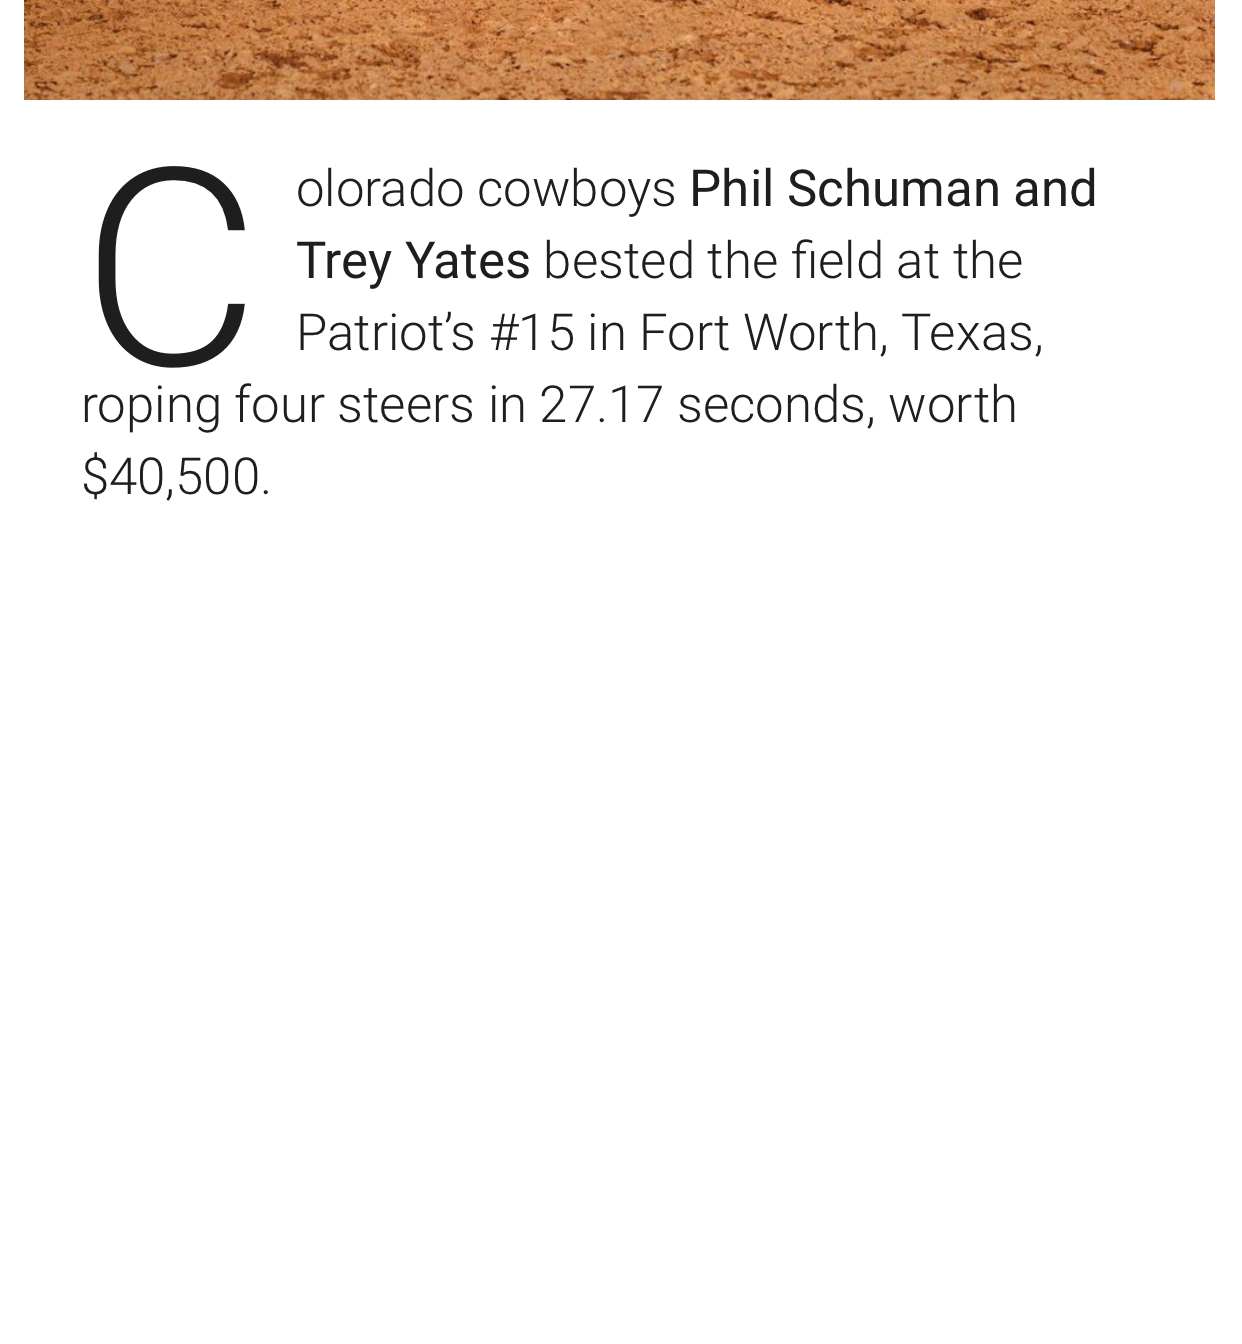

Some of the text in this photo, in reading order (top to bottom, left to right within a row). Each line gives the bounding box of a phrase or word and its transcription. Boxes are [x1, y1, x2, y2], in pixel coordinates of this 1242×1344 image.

[478, 166, 675, 218] cowboys
[692, 166, 772, 207] Phil
[788, 166, 999, 208] Schuman
[1015, 166, 1095, 208] and
[296, 238, 1023, 290] Trey Yates bested the field at the
[299, 310, 1042, 358] Patriot’s #15 in Fort Worth, Texas,
[84, 382, 1015, 434] roping four steers in 27.17 seconds, worth
[83, 451, 269, 502] $40,500.
